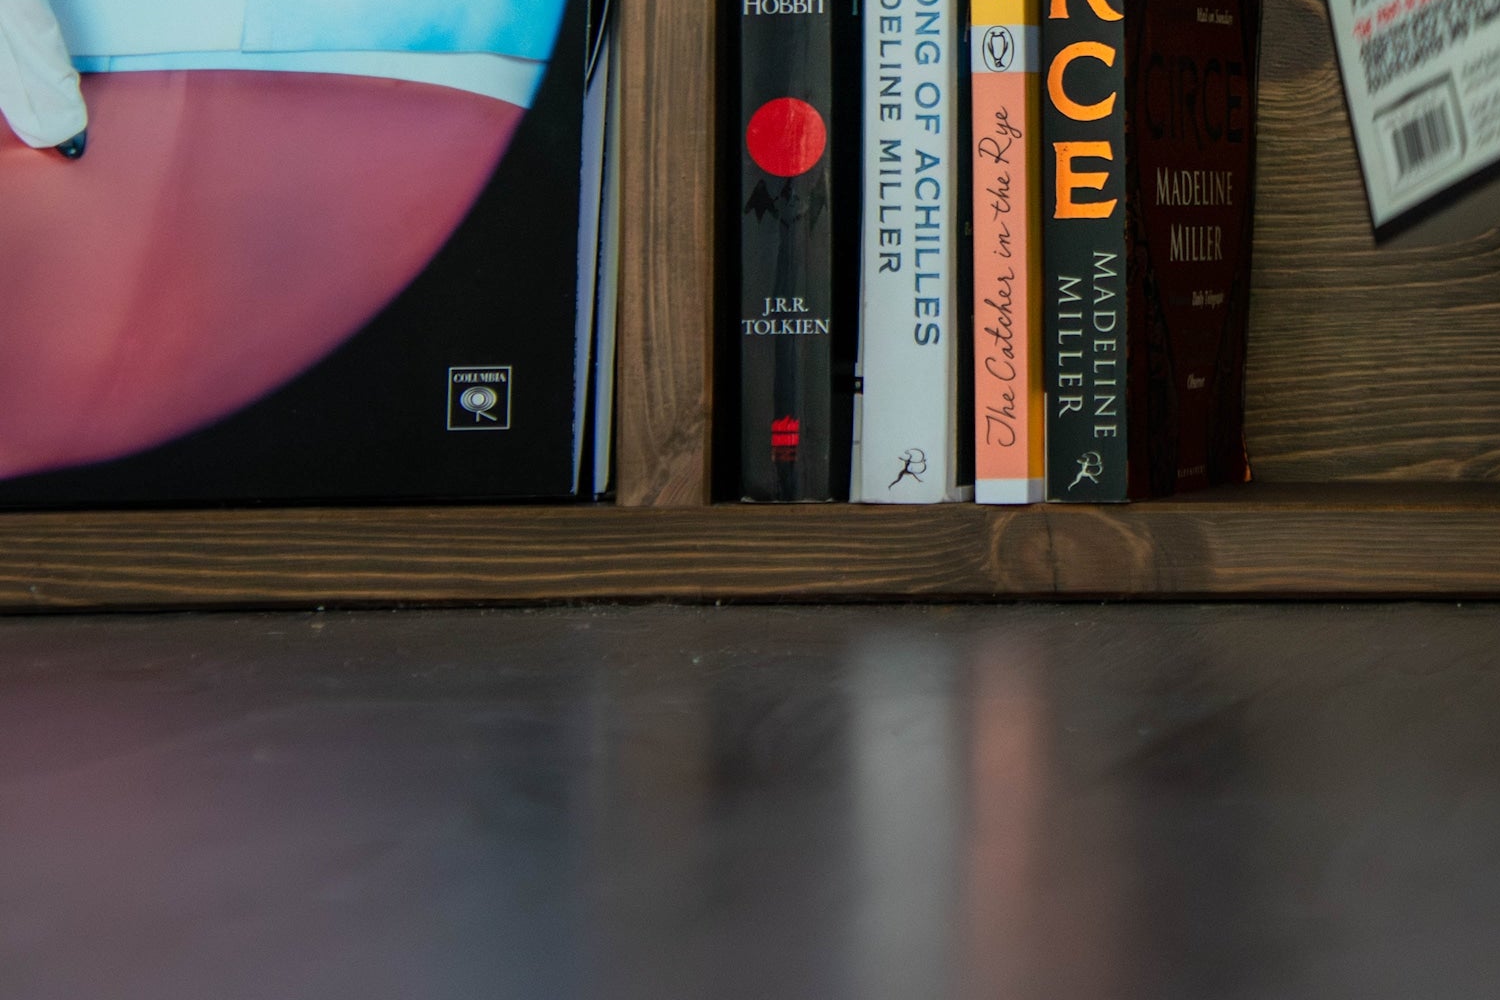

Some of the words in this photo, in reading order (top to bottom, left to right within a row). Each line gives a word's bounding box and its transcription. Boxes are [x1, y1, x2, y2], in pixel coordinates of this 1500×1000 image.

[914, 81, 941, 135] OF
[978, 105, 1023, 165] Rye
[879, 139, 902, 274] MILLER
[986, 171, 1013, 223] the
[1155, 165, 1233, 206] MADELINE
[914, 149, 941, 346] ACHILLES
[993, 221, 1013, 259] in
[1169, 222, 1223, 263] MILLER
[741, 319, 830, 335] TOLKIEN
[762, 297, 809, 316] J.R.R.
[983, 265, 1017, 382] Catcher
[1058, 275, 1083, 418] MILLER
[1093, 251, 1118, 439] MADELINE
[453, 371, 507, 383] COLUMBIA
[986, 382, 1016, 448] The
